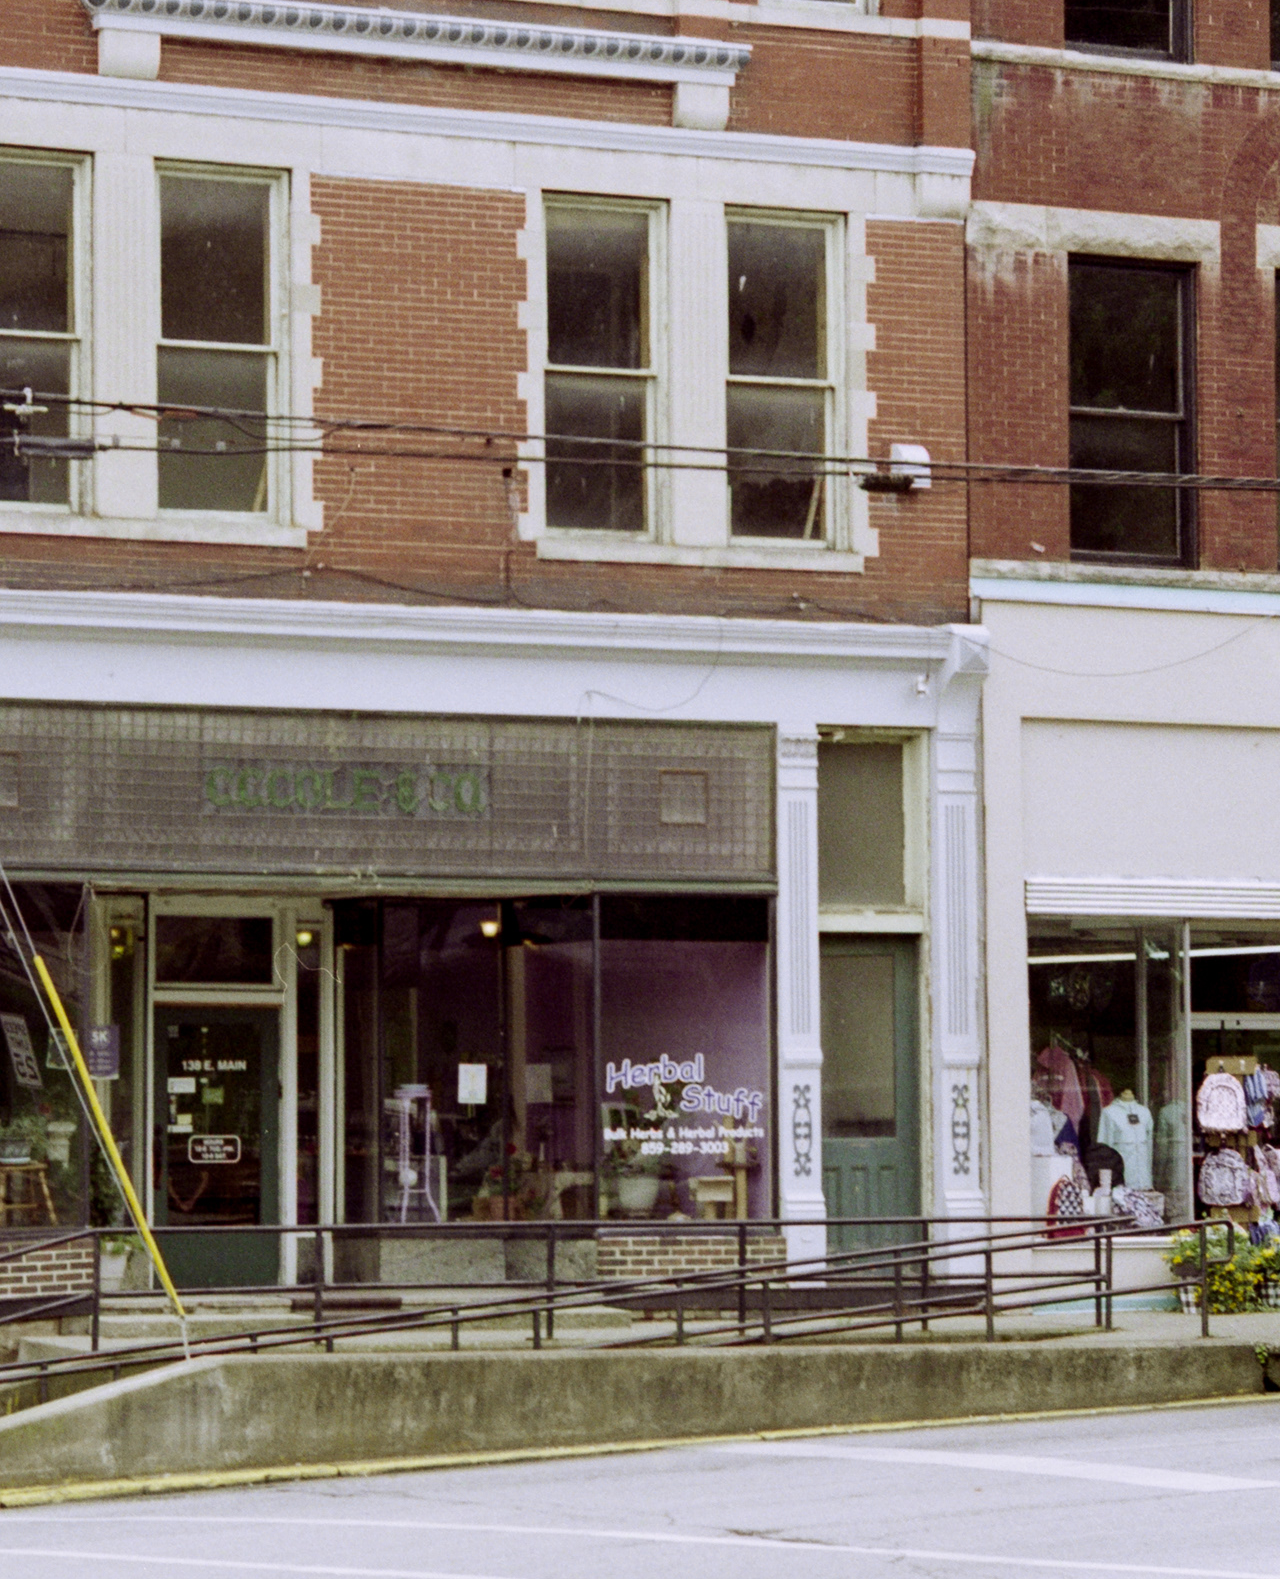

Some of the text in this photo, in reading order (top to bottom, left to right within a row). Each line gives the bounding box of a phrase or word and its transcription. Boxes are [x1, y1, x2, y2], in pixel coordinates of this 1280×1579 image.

[217, 1059, 247, 1072] MAIN
[605, 1052, 705, 1094] Herbal
[679, 1083, 763, 1123] Stuff
[603, 1125, 765, 1141] Bulk Herbs & Herbal Products
[640, 1141, 730, 1155] 859-289-3003
